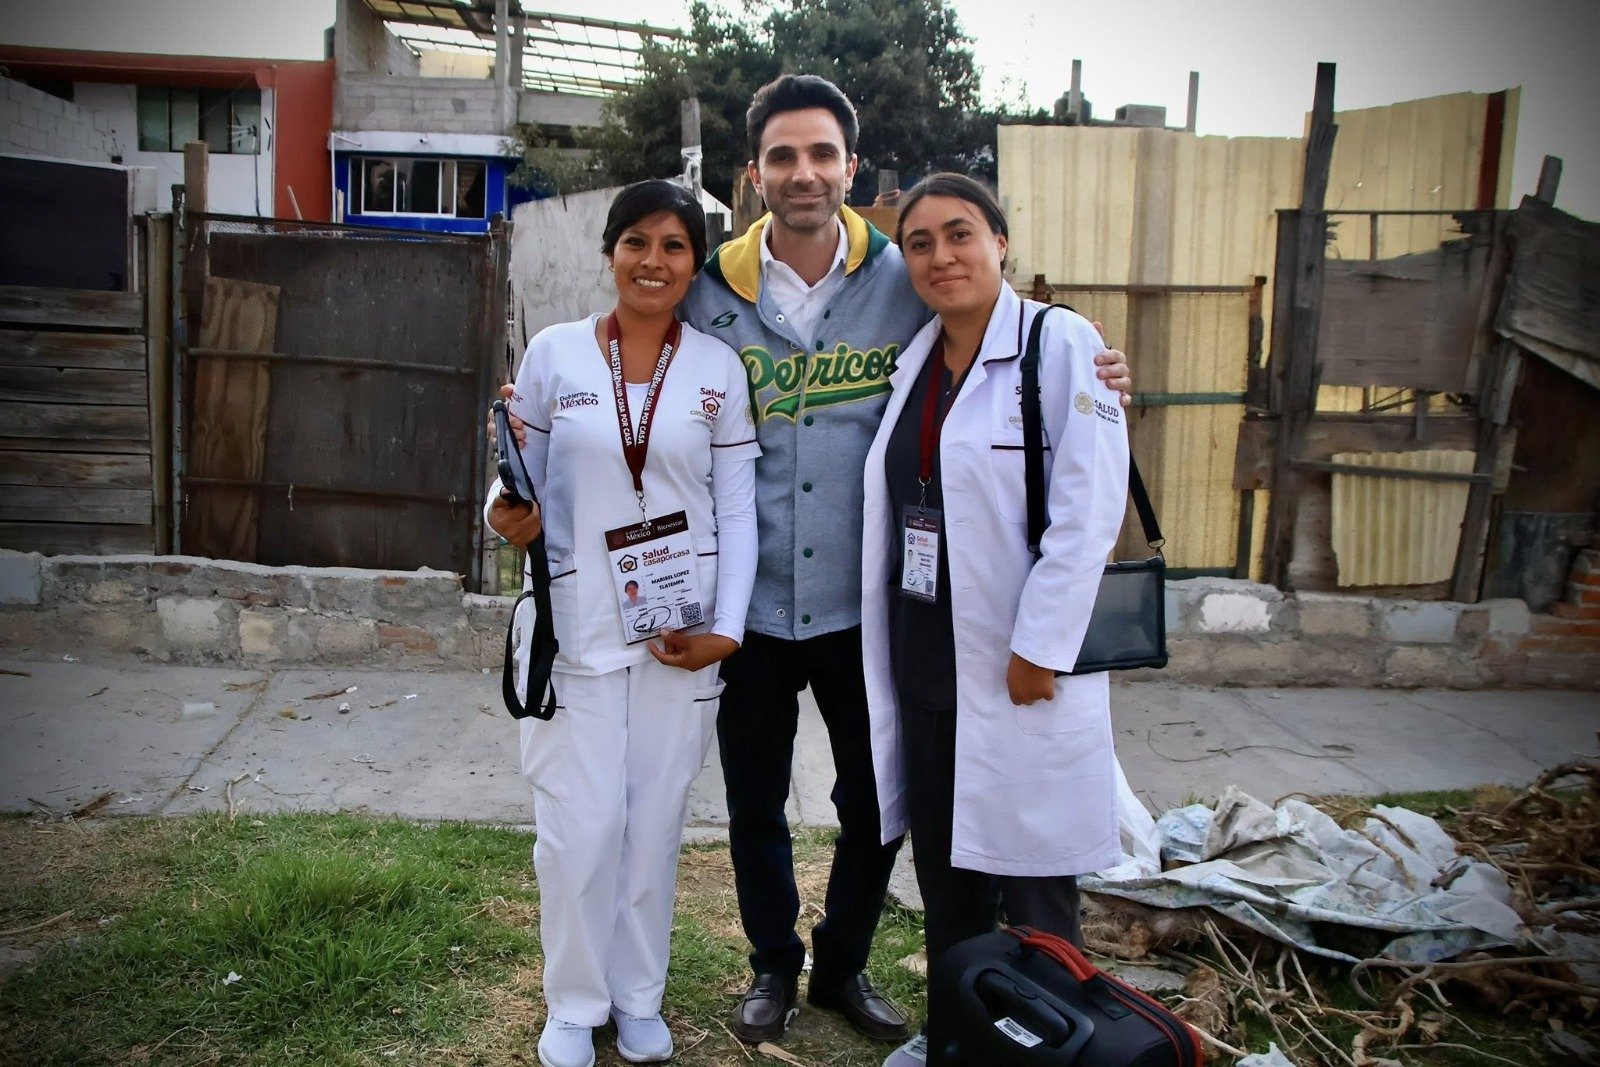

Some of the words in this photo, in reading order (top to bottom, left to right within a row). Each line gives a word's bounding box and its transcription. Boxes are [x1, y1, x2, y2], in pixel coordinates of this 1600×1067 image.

[609, 338, 622, 382] BIENESTAR
[652, 342, 673, 382] BIENESTAR
[615, 380, 623, 398] SALUD
[647, 379, 658, 397] SALUD
[740, 342, 899, 422] Pericos
[559, 391, 589, 401] Gobierno
[700, 387, 726, 400] Salud
[560, 397, 599, 411] México
[617, 398, 626, 413] CASA
[643, 397, 653, 412] CASA
[1094, 399, 1119, 418] SALUD
[620, 413, 629, 427] POR
[640, 412, 649, 425] POR
[623, 428, 633, 447] CASA
[637, 426, 646, 445] CASA
[656, 520, 684, 531] Bienestar
[626, 530, 651, 541] México
[642, 546, 669, 560] Salud
[643, 549, 690, 567] casaporcasa
[651, 575, 673, 584] MARIBEL
[673, 570, 690, 578] LOPEZ
[659, 579, 685, 590] TLATEMPA
